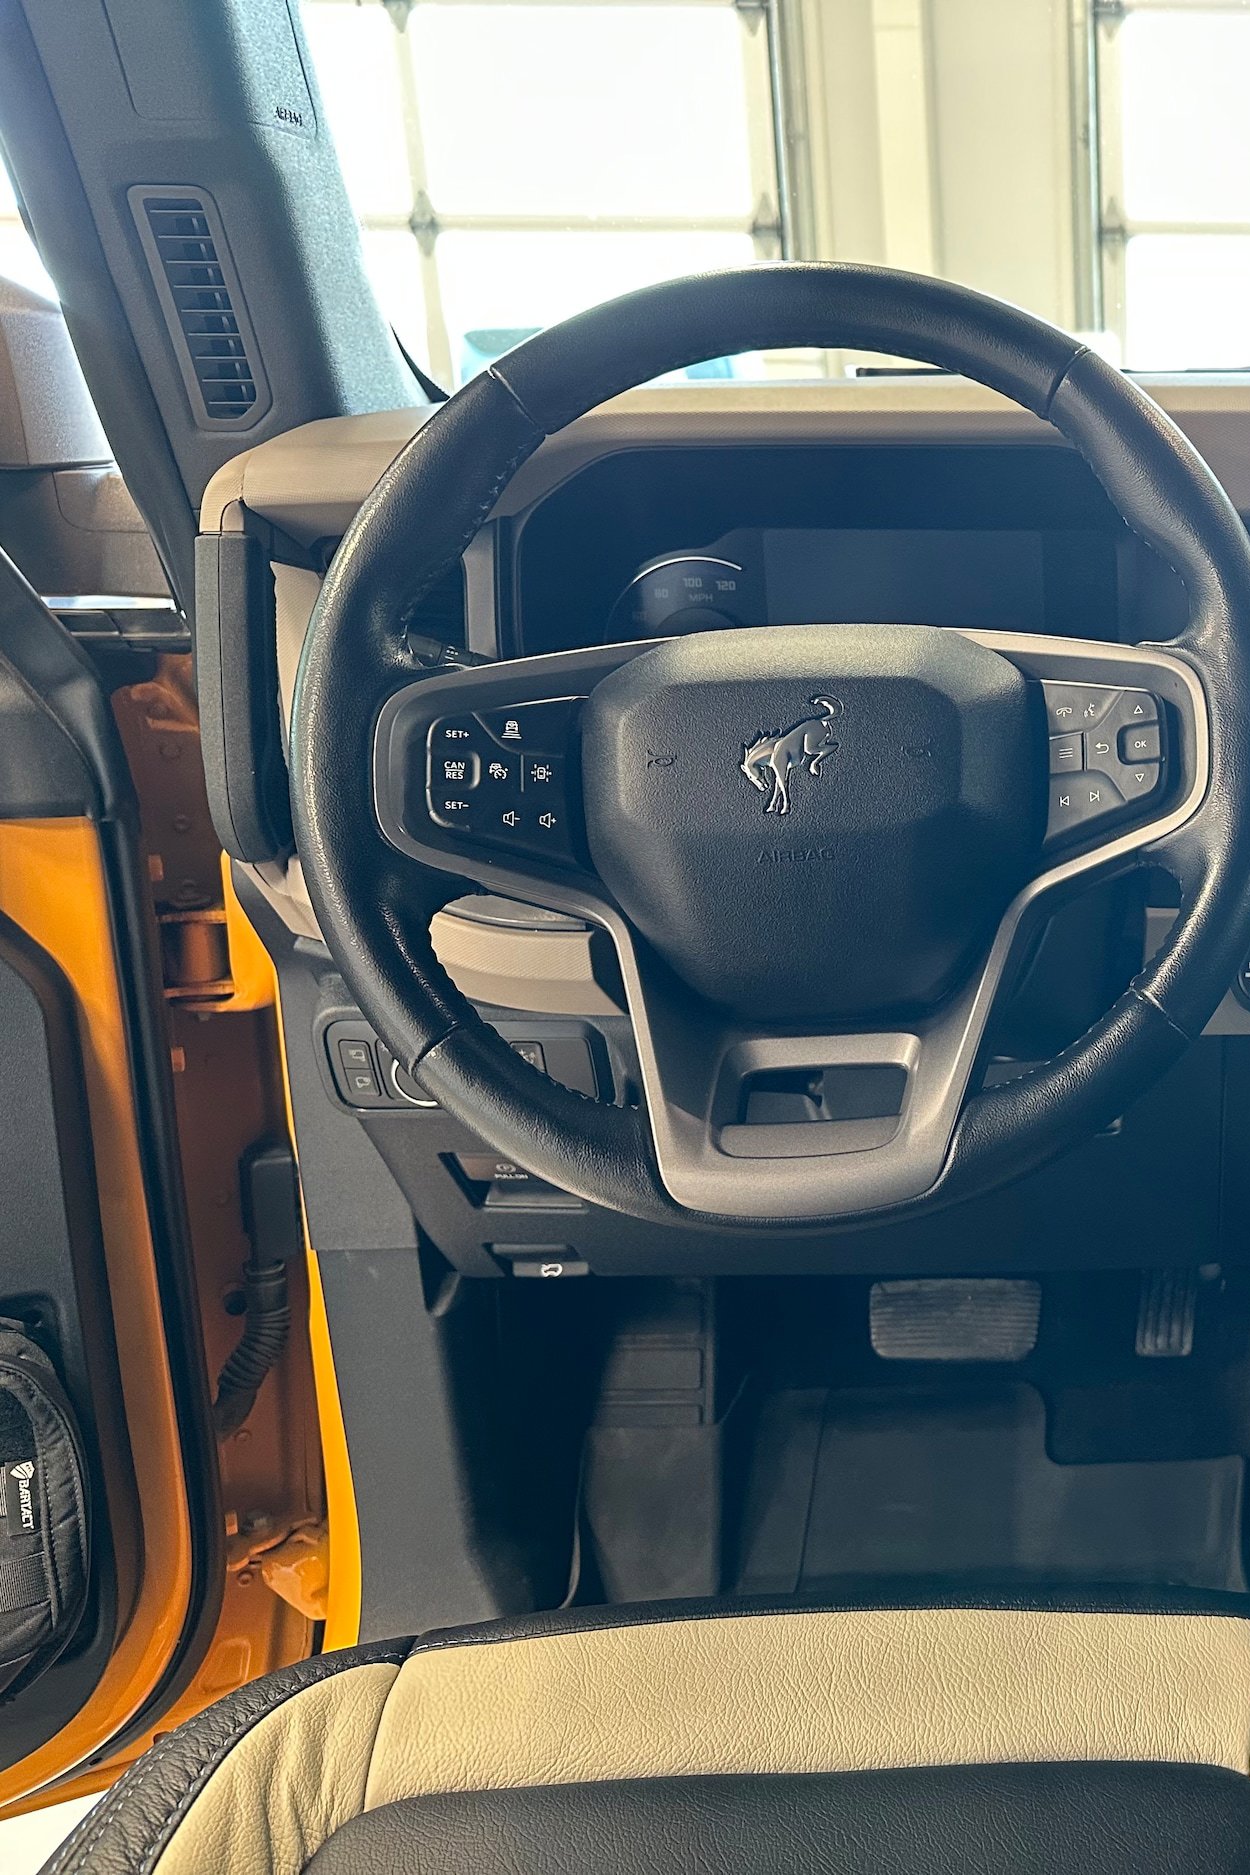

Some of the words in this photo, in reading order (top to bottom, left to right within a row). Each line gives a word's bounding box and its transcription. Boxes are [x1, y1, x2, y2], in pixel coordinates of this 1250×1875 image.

[683, 577, 703, 588] 100
[715, 580, 736, 591] 120
[445, 729, 470, 739] SET+
[1134, 740, 1147, 749] OK
[444, 761, 466, 770] CAN
[445, 771, 465, 780] RES
[445, 801, 470, 810] SET-
[19, 1479, 34, 1529] BARTACT
